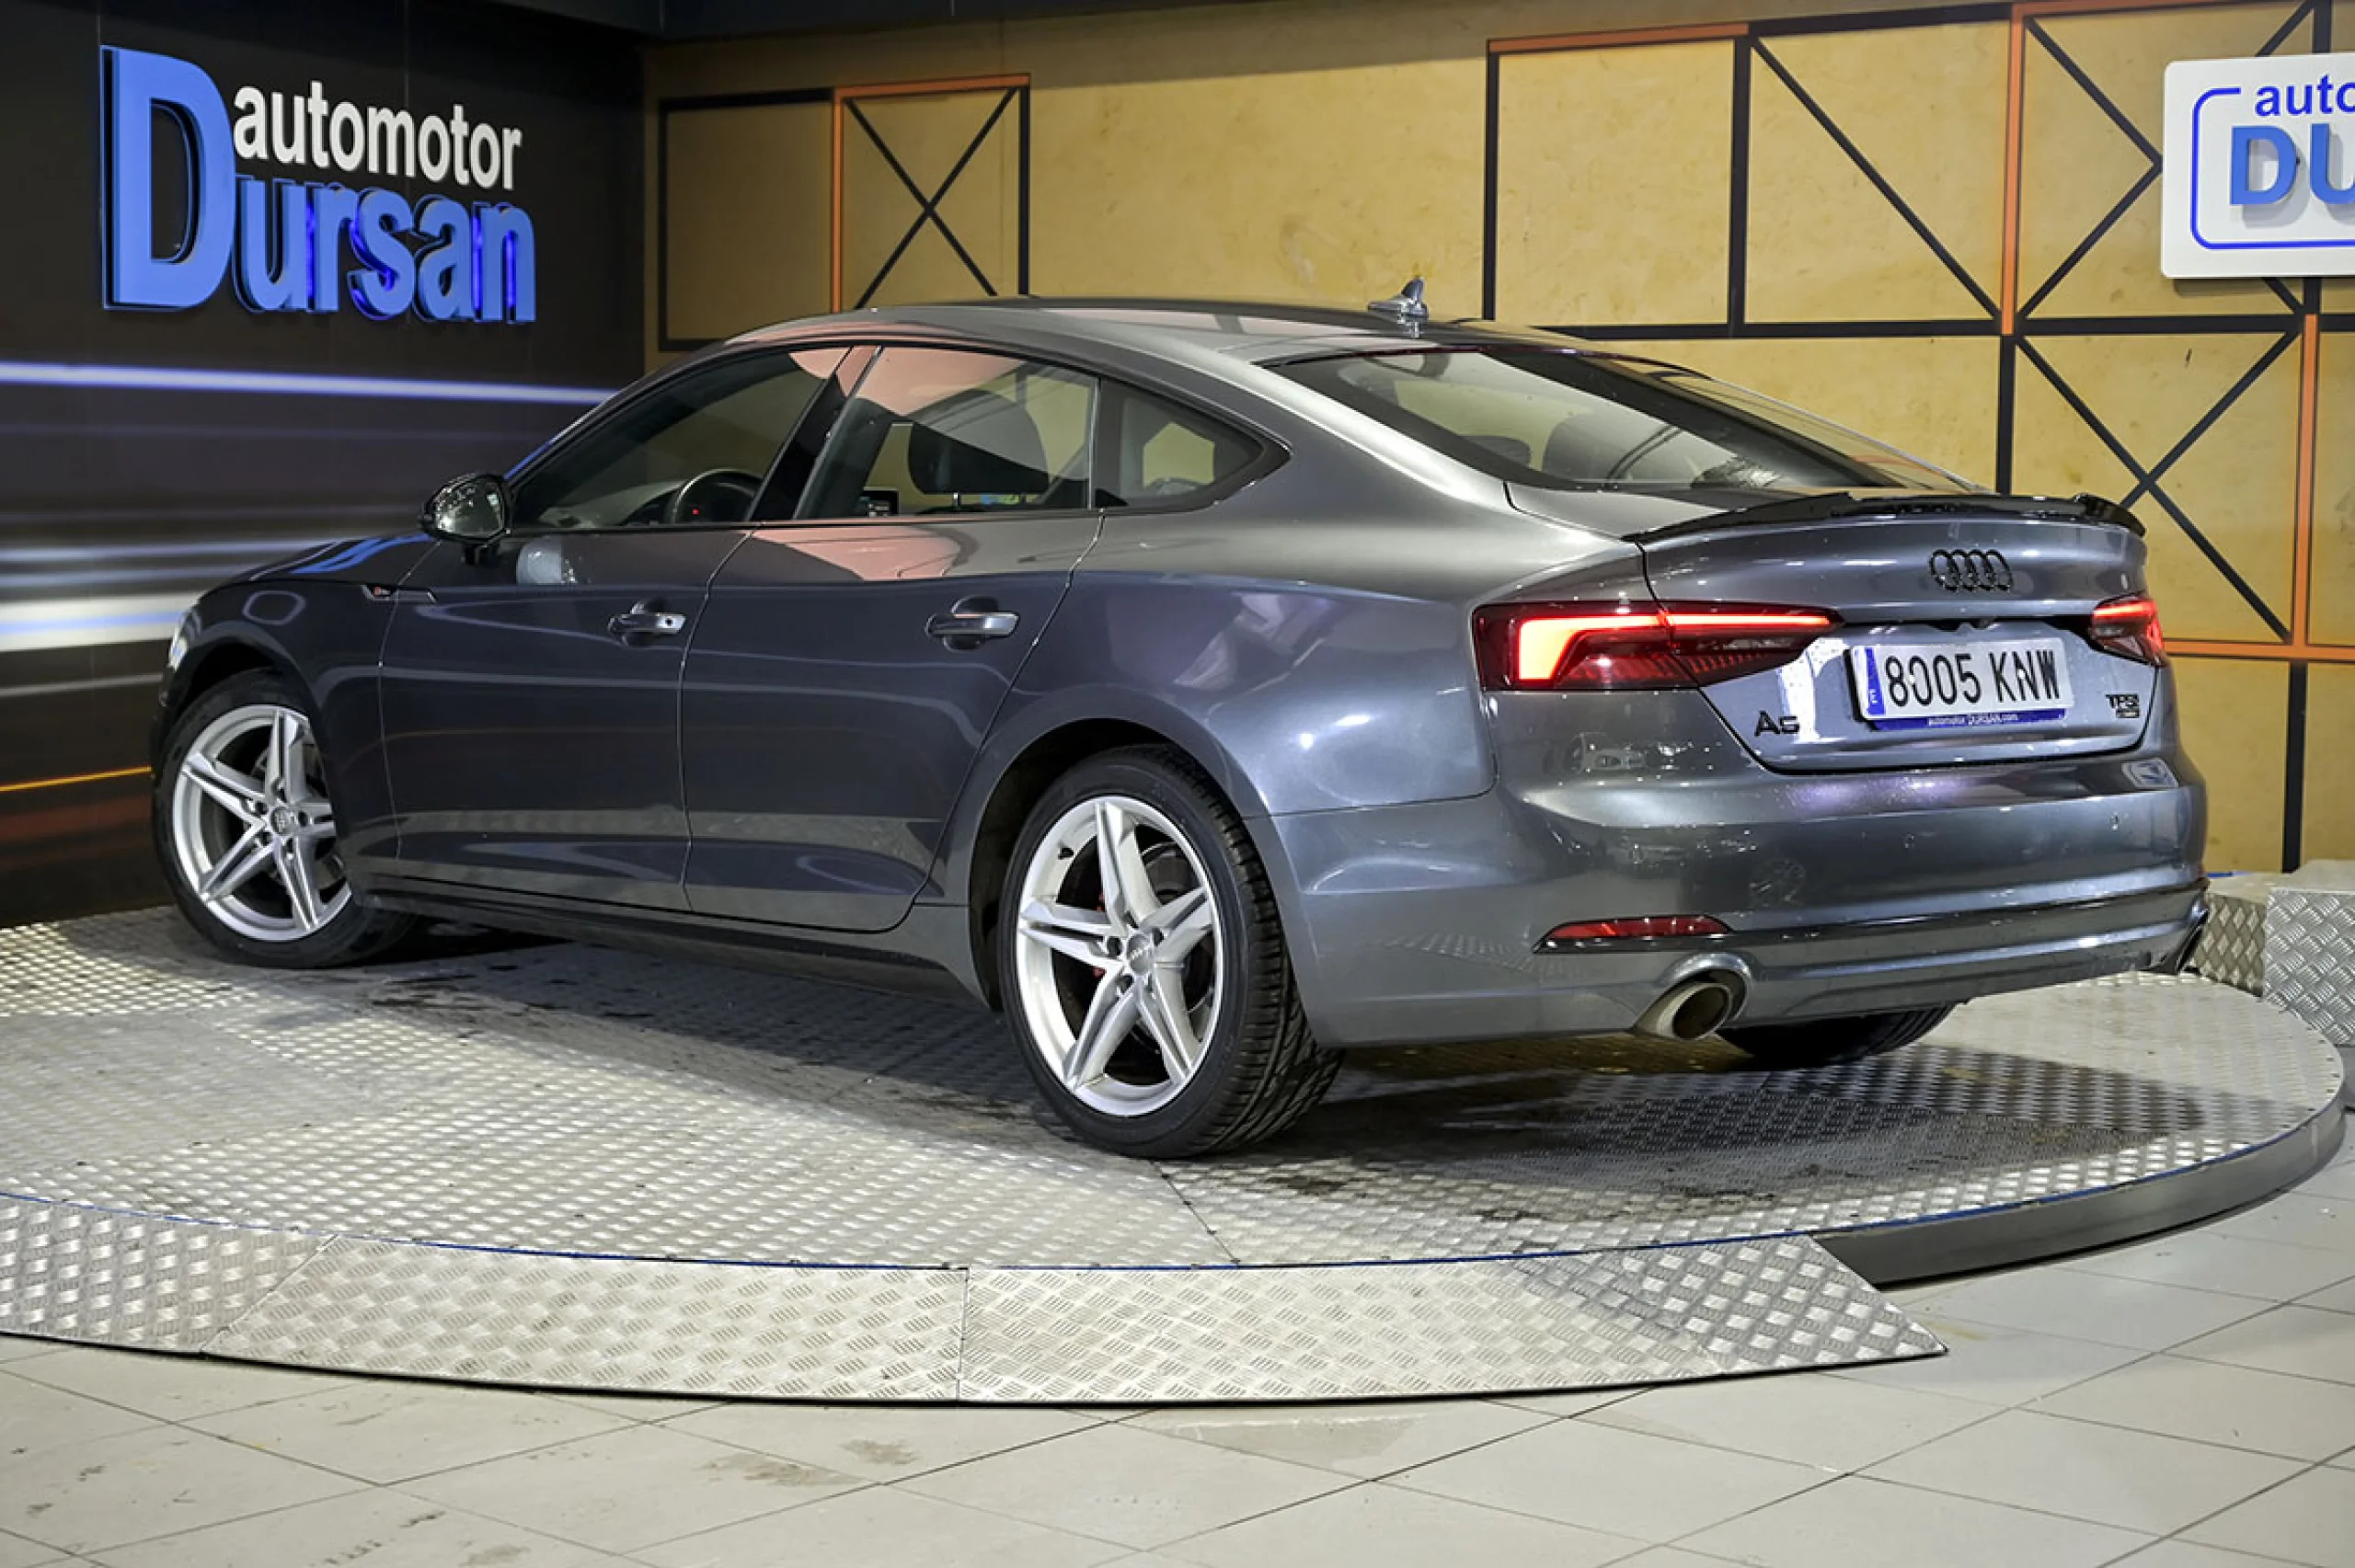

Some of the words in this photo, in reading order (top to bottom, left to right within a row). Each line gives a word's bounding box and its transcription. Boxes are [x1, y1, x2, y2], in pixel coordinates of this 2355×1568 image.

[233, 80, 523, 189] automotor
[99, 44, 537, 325] Dursan
[1885, 653, 1982, 707] 8005
[1988, 649, 2061, 704] KNW
[1753, 709, 1800, 738] A5
